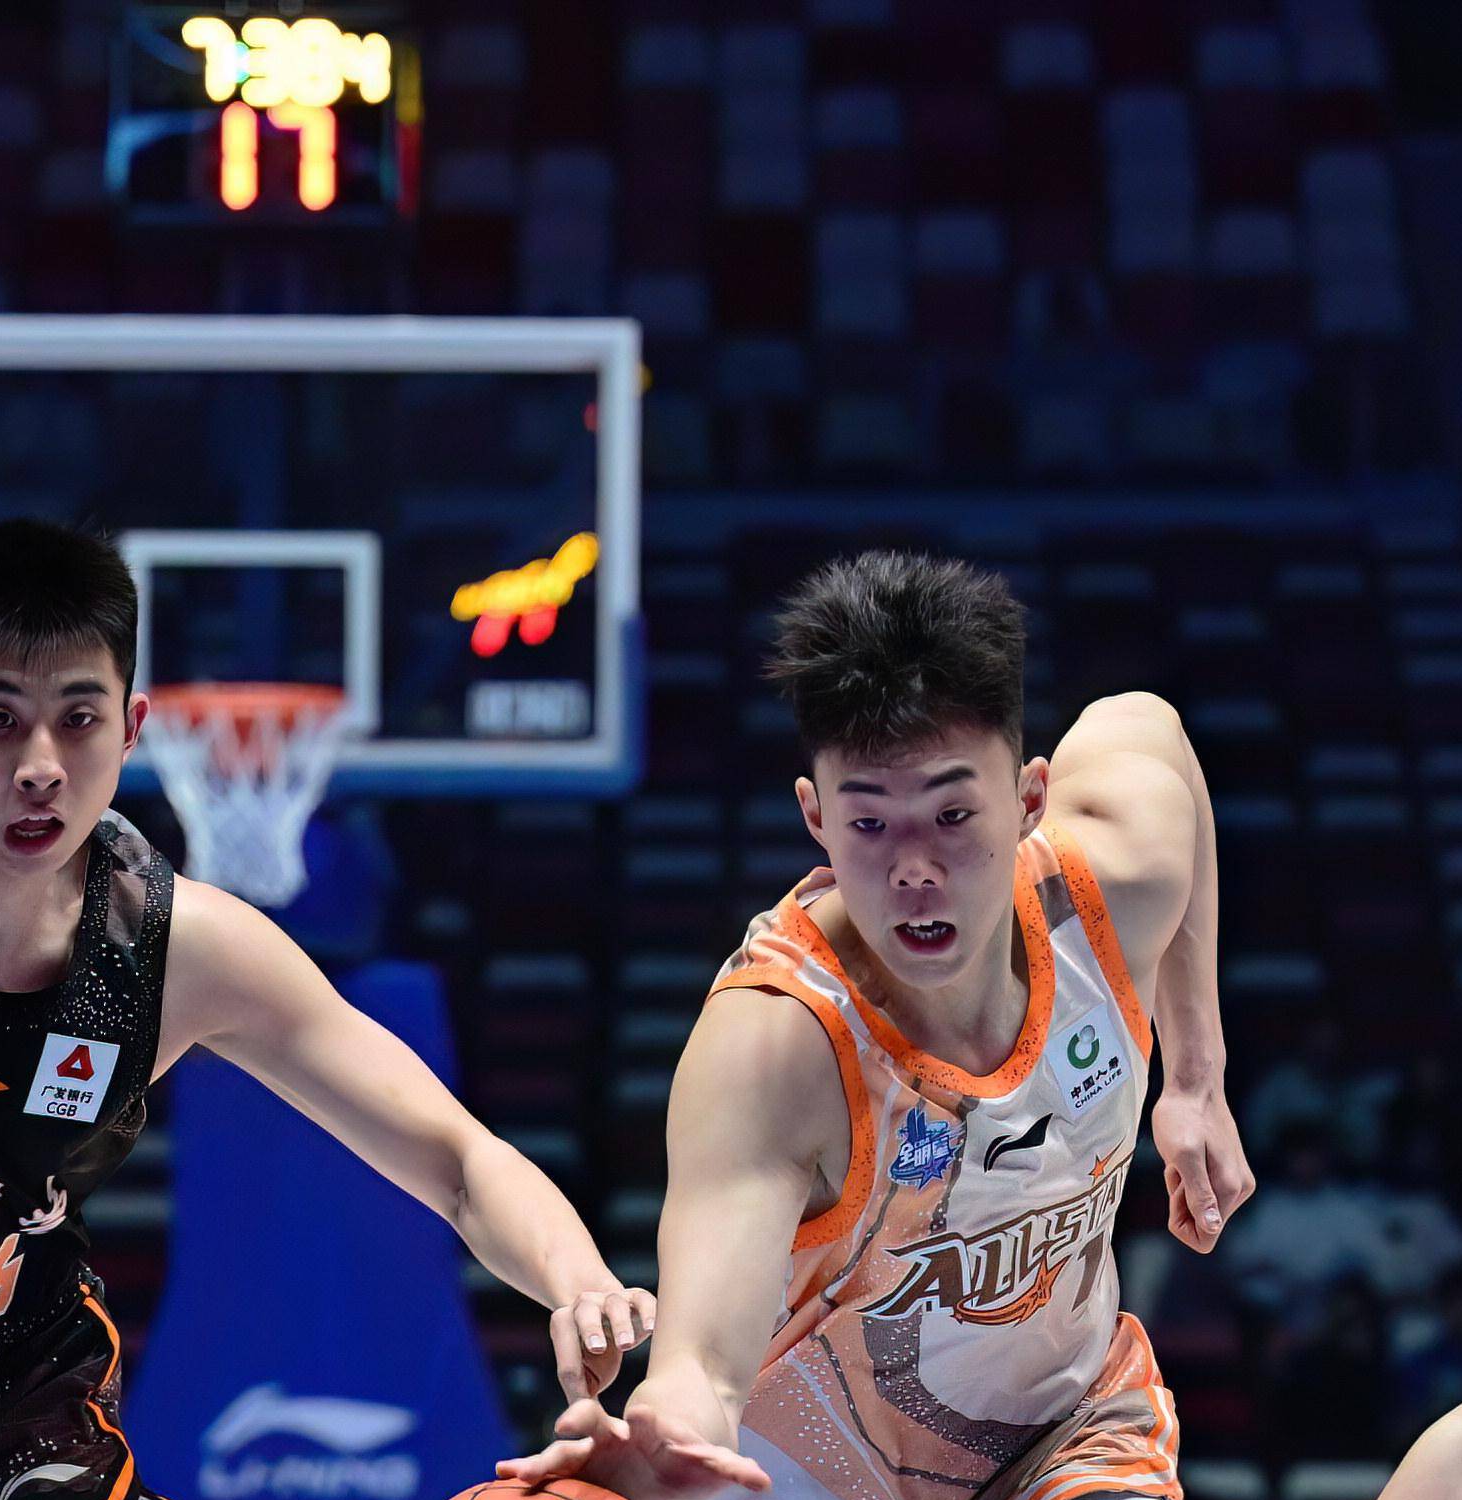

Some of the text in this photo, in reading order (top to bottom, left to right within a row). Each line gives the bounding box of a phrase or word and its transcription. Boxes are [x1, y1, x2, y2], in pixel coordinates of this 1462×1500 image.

[221, 101, 336, 211] 17
[41, 1085, 94, 1104] 广发银行
[1070, 1056, 1119, 1099] 中国人寿
[1075, 1068, 1123, 1108] CHINA LIFE
[46, 1101, 78, 1117] CGB
